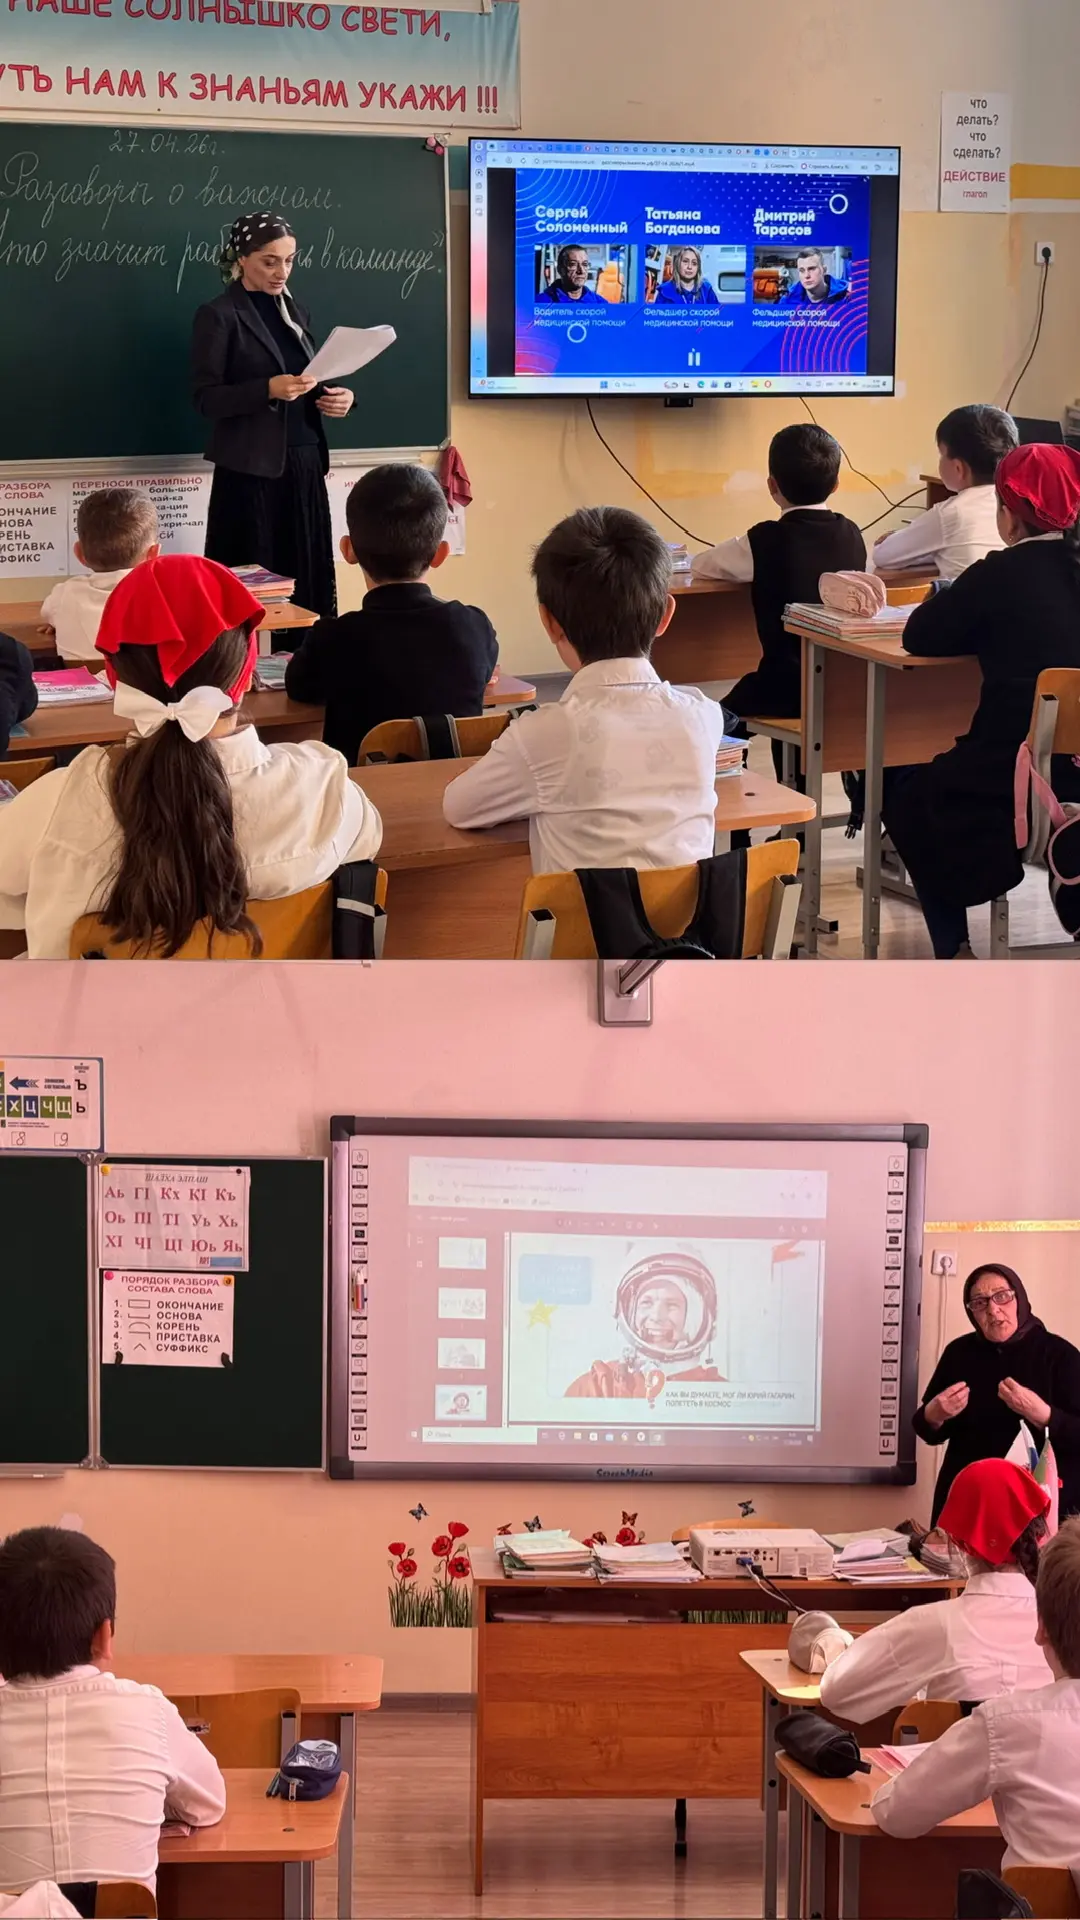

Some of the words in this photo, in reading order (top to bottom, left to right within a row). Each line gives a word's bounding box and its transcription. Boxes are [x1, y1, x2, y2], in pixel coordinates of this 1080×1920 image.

[125, 0, 330, 31] СОЛНЫШКО
[341, 6, 450, 42] СВЕТИ,
[66, 66, 146, 98] НАМ
[158, 71, 178, 98] К
[189, 73, 348, 108] ЗНАНЬЯМ
[358, 81, 466, 112] УКАЖИ
[477, 85, 498, 114] !!!
[970, 99, 988, 109] что
[956, 114, 999, 126] делать?
[969, 132, 987, 141] что
[953, 146, 1001, 159] сделать?
[943, 170, 1006, 182] ДЕЙСТВИЕ
[962, 190, 988, 198] глагол
[535, 205, 588, 220] Сергей
[645, 207, 701, 220] Татьяна
[754, 208, 815, 224] Дмитрий
[535, 221, 628, 234] Соломенный
[645, 222, 720, 236] Богданова
[754, 223, 812, 238] Тарасов
[534, 307, 573, 316] Водитель
[576, 308, 606, 316] скорой
[644, 308, 687, 317] Фельдшер
[690, 309, 719, 317] скорой
[752, 308, 795, 318] Фельдшер
[798, 309, 826, 317] скорой
[534, 319, 590, 328] медицинской
[592, 320, 626, 328] помощи
[644, 320, 698, 328] медицинской
[701, 320, 733, 328] помощи
[752, 320, 806, 328] медицинской
[808, 320, 840, 328] помощи
[0, 482, 51, 490] РАЗБОРА
[72, 480, 133, 489] ПЕРЕНОСИ
[136, 477, 203, 487] ПРАВИЛЬНО
[75, 1079, 87, 1090] Ъ
[26, 1100, 36, 1114] Ц
[43, 1101, 52, 1112] Ч
[57, 1101, 71, 1115] Щ
[76, 1102, 86, 1113] Ь
[16, 1131, 26, 1146] 8
[60, 1132, 68, 1147] 9
[104, 1187, 125, 1198] Аь
[161, 1188, 180, 1200] Кх
[215, 1189, 236, 1201] Къ
[105, 1211, 126, 1224] Оь
[192, 1214, 211, 1227] Уь
[218, 1215, 238, 1227] Хь
[191, 1240, 217, 1252] Юь
[222, 1240, 243, 1252] Яь
[121, 1275, 170, 1285] ПОРЯДОК
[173, 1277, 220, 1286] РАЗБОРА
[127, 1285, 175, 1294] СОСТАВА
[178, 1287, 213, 1295] СЛОВА
[156, 1301, 224, 1311] ОКОНЧАНИЕ
[156, 1311, 203, 1320] ОСНОВА
[156, 1322, 200, 1331] КОРЕНЬ
[156, 1333, 221, 1343] ПРИСТАВКА
[156, 1343, 209, 1353] СУФФИКС
